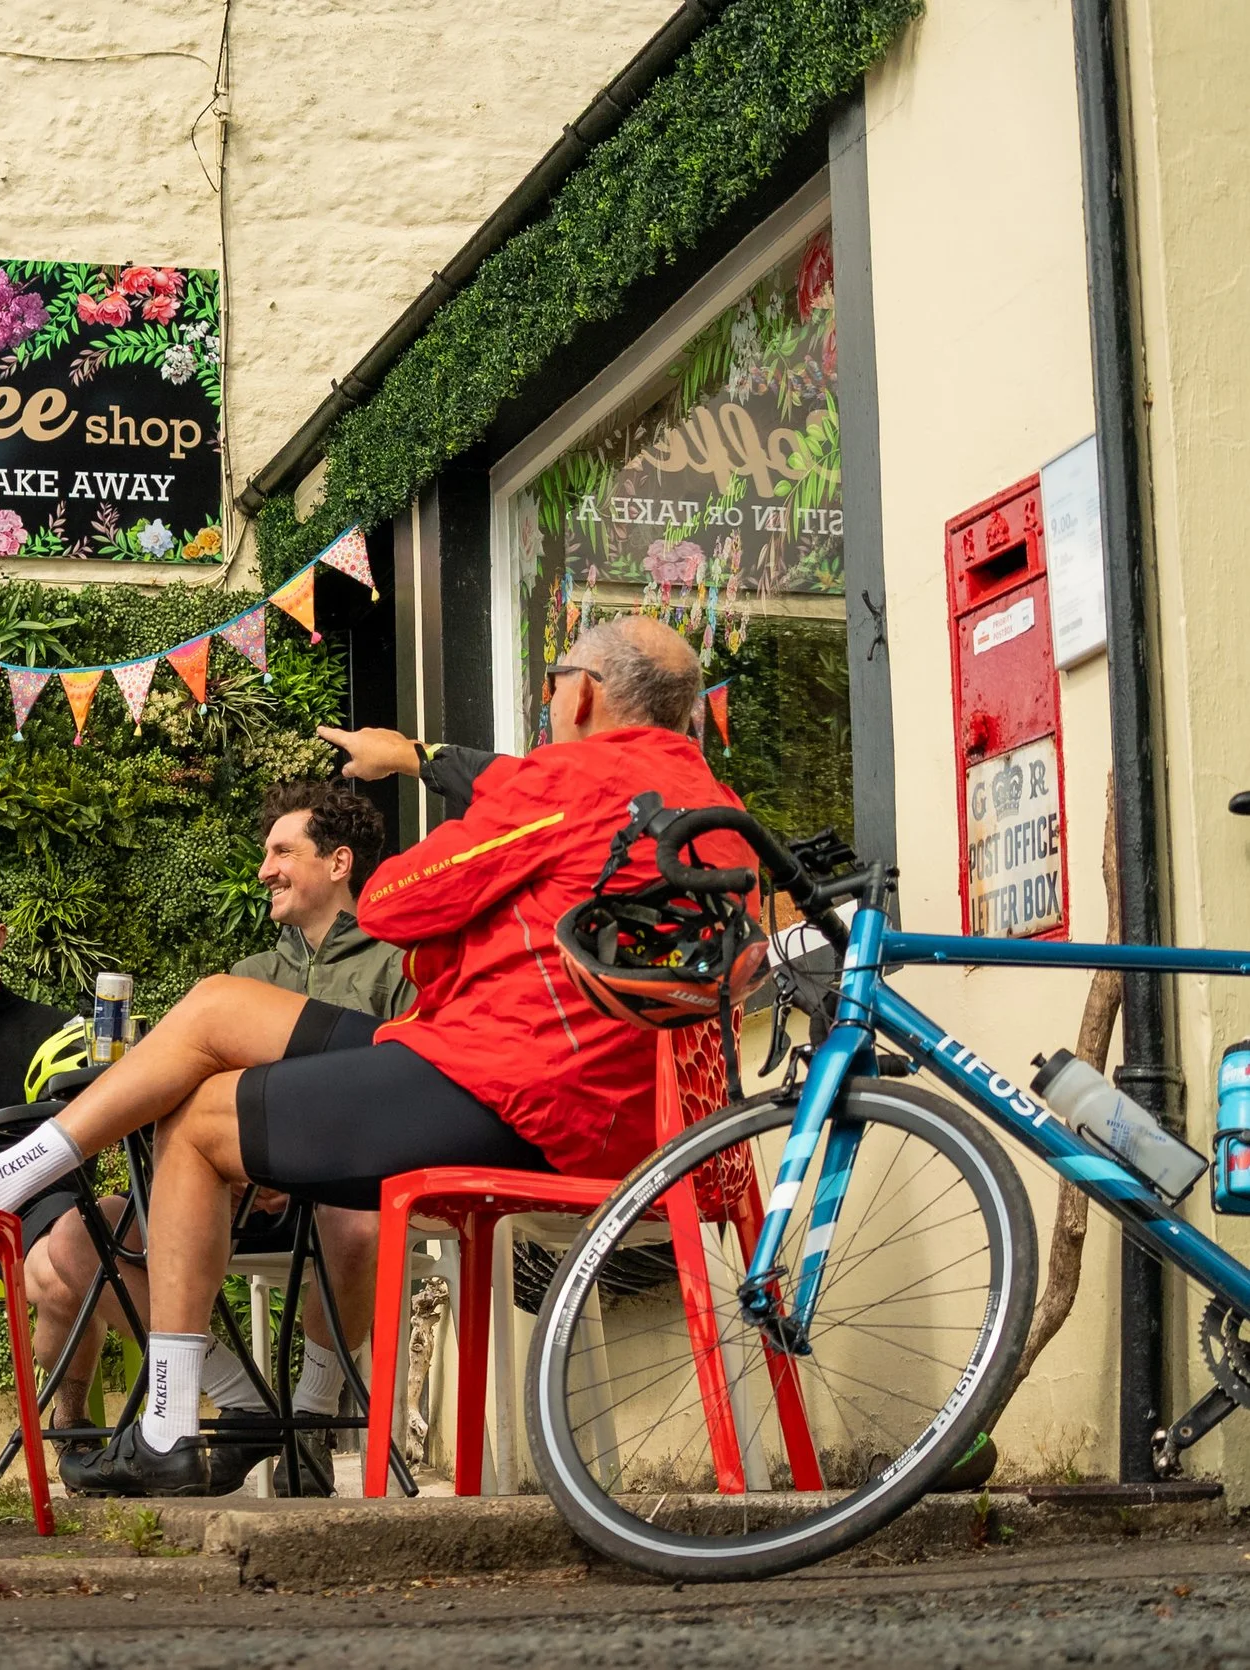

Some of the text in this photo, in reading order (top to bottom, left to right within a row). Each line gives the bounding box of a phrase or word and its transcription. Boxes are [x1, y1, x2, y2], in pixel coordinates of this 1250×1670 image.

[85, 405, 202, 459] shop
[69, 472, 175, 501] AWAY
[972, 760, 1049, 821] G R
[969, 813, 1058, 884] POST OFFICE
[369, 859, 452, 902] GORE BIKE WEAR
[971, 871, 1059, 937] LETTER BOX
[936, 1033, 1051, 1129] TIFOSI
[153, 1358, 168, 1418] MCKENZIE
